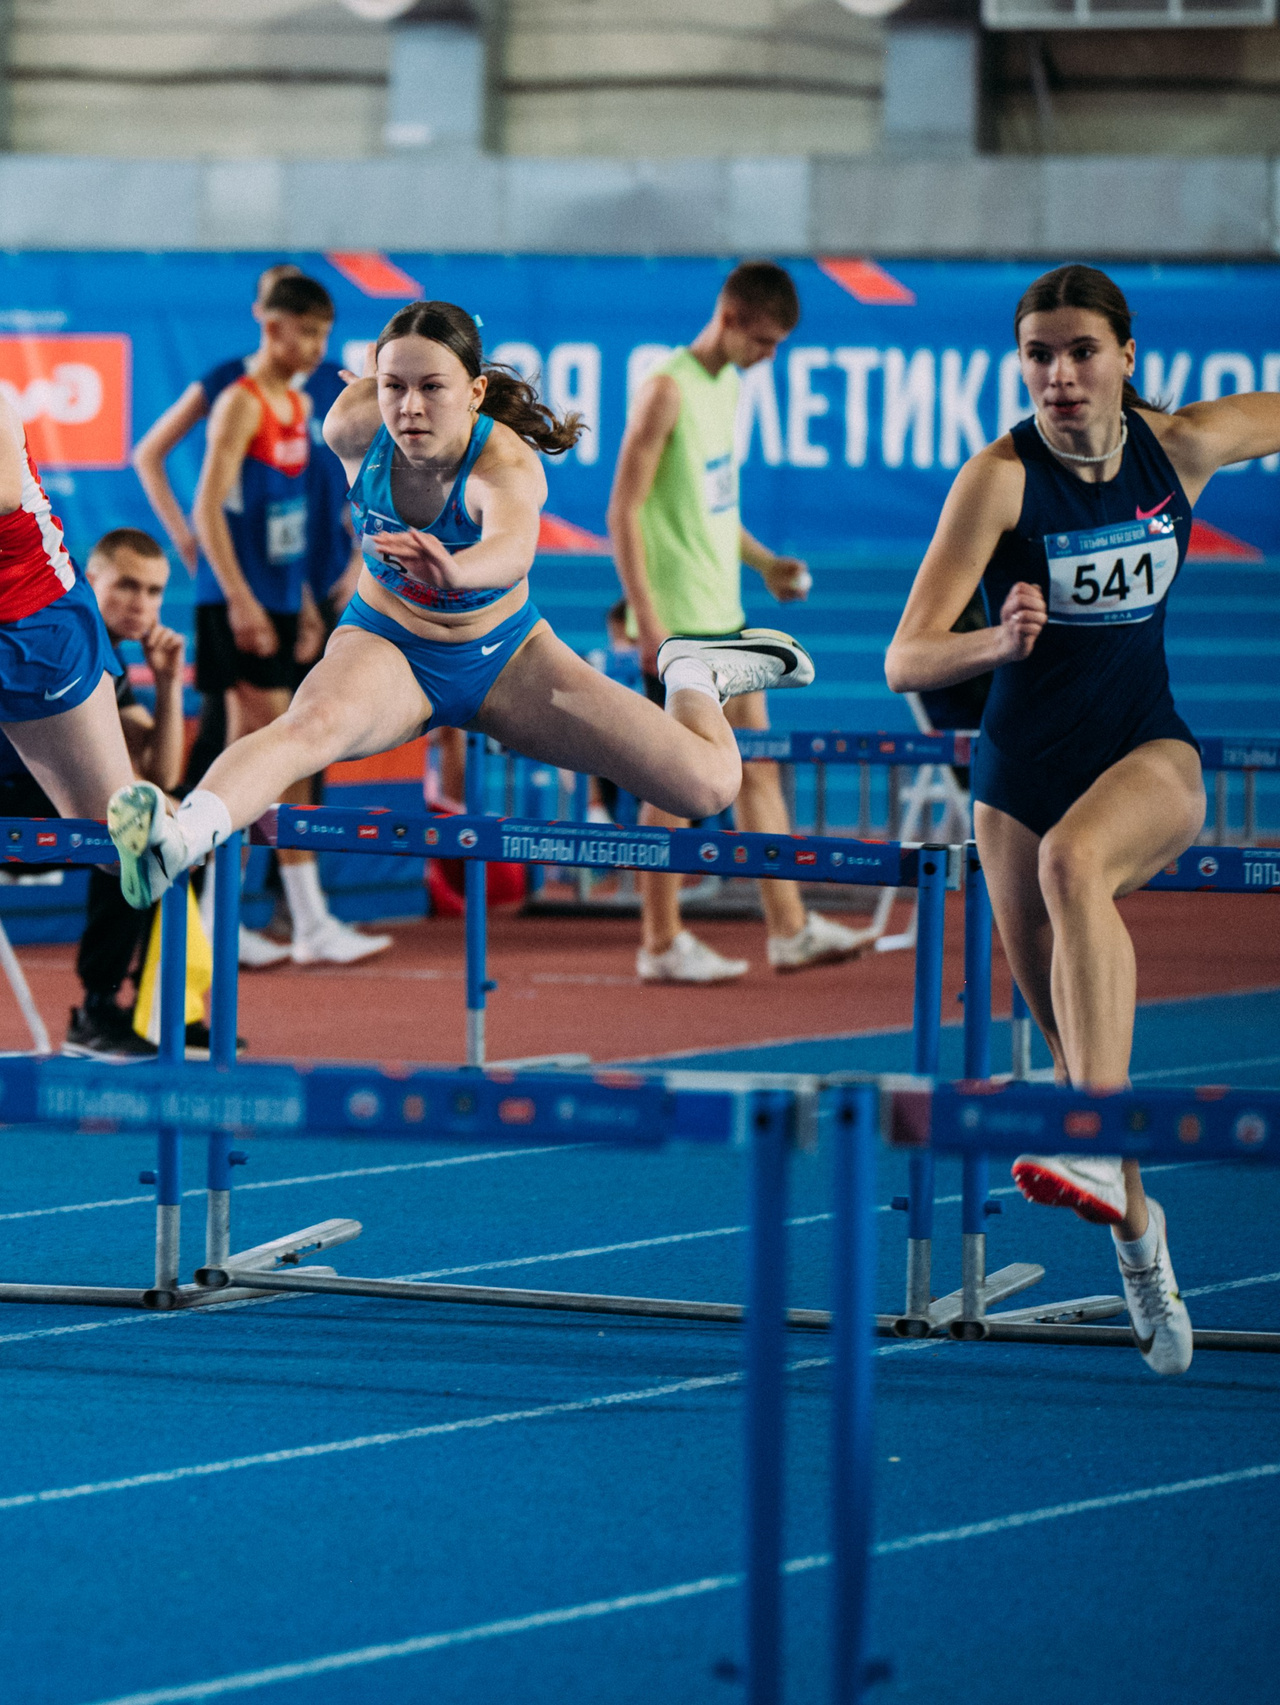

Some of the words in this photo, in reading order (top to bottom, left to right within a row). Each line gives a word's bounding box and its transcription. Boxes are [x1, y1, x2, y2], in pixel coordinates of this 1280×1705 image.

[1071, 552, 1154, 606] 541
[501, 835, 575, 862] ТАТЬЯНЫ
[577, 840, 670, 868] ЛЕБЕДЕВОЙ
